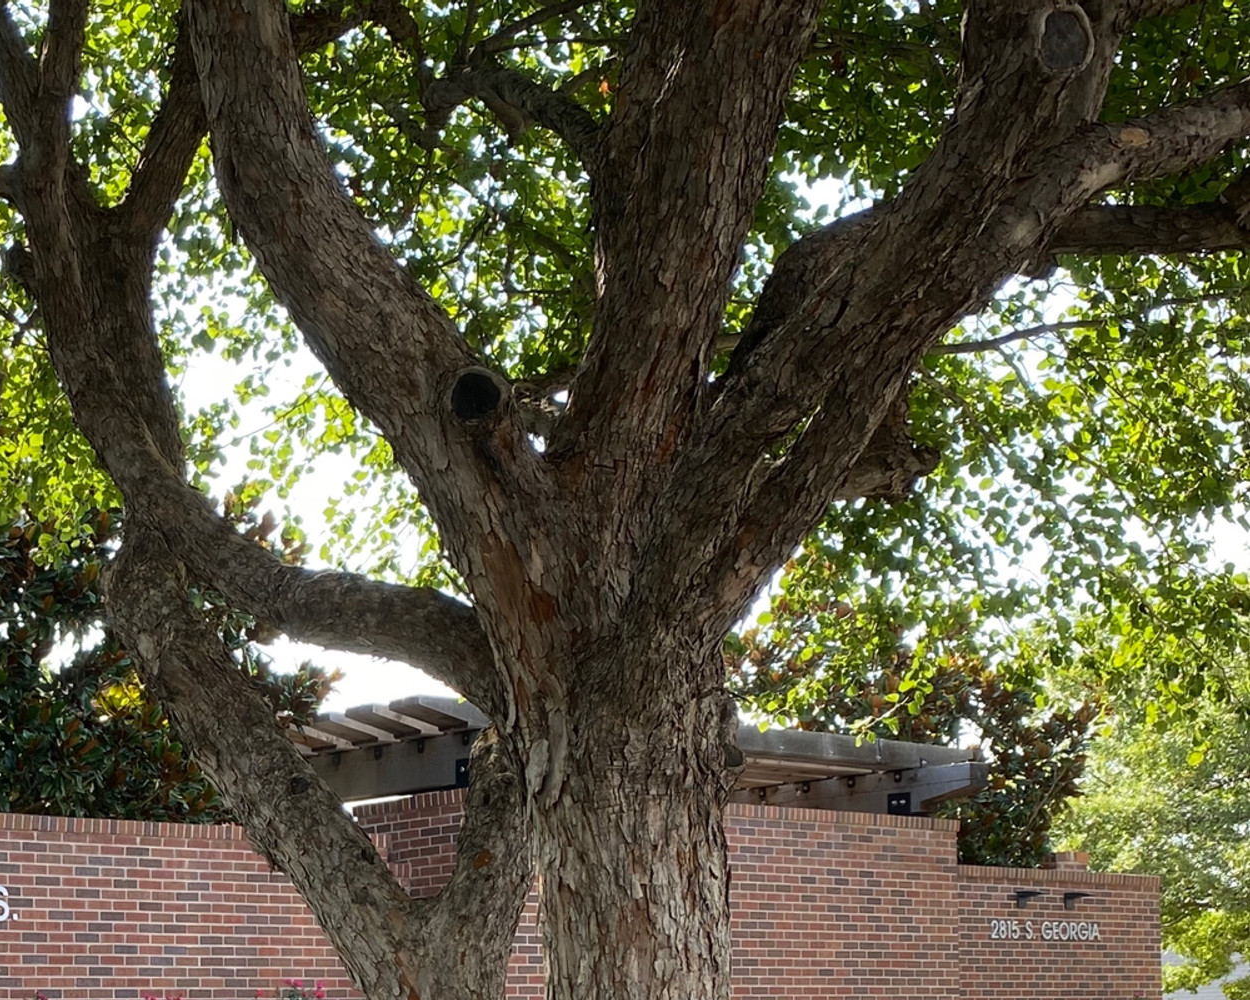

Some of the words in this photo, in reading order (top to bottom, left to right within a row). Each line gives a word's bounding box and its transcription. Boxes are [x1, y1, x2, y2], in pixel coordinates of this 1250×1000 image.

[991, 919, 1020, 939] 2815
[1025, 920, 1037, 940] S.
[1041, 921, 1101, 941] GEORGIA
